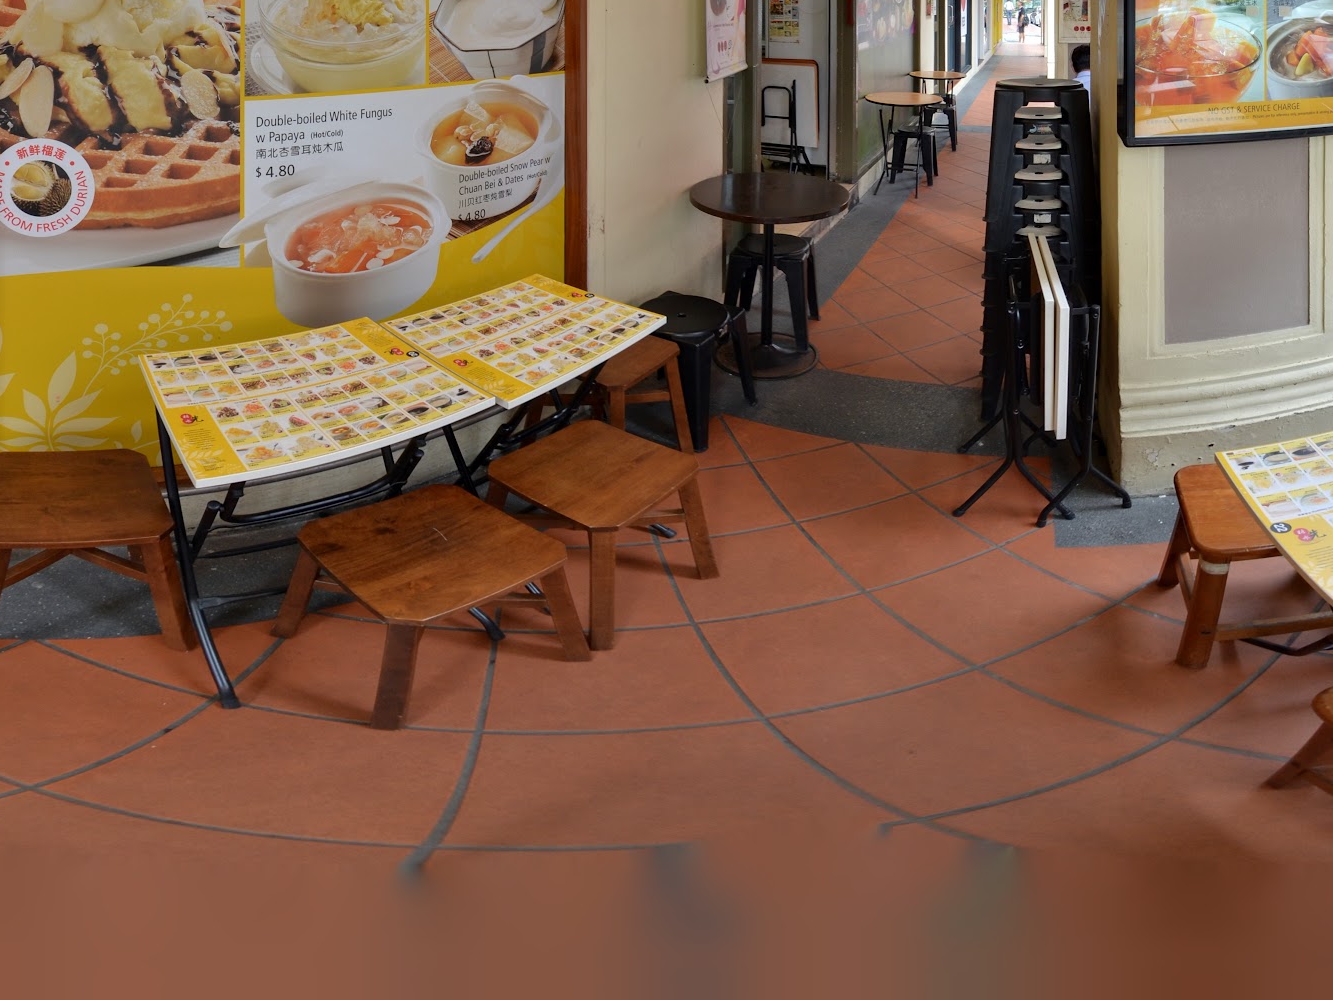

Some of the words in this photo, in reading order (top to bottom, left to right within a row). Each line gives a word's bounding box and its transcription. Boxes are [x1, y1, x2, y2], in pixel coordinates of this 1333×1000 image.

[256, 111, 327, 128] Double-boiled
[329, 109, 358, 122] White
[360, 107, 393, 121] Fungus
[1208, 107, 1218, 115] NO
[1221, 106, 1233, 114] GST
[1237, 105, 1242, 113] &
[1243, 103, 1271, 113] SERVICE
[1272, 102, 1300, 111] CHARGE
[269, 130, 305, 144] Papaya
[310, 129, 344, 140] (Hot/Cold)
[15, 144, 67, 161] 新鲜榴莲
[255, 141, 344, 160] 南北杏雪耳炖木瓜
[458, 164, 509, 183] Double-boiled
[510, 162, 528, 172] Snow
[529, 158, 543, 168] Pear
[458, 184, 483, 196] Chuan
[484, 180, 496, 190] Bei
[497, 179, 503, 187] &
[505, 175, 524, 185] Dates
[0, 207, 33, 232] FROM
[36, 214, 73, 233] FRESH
[70, 170, 88, 216] DURIAN
[1274, 523, 1288, 533] 22
